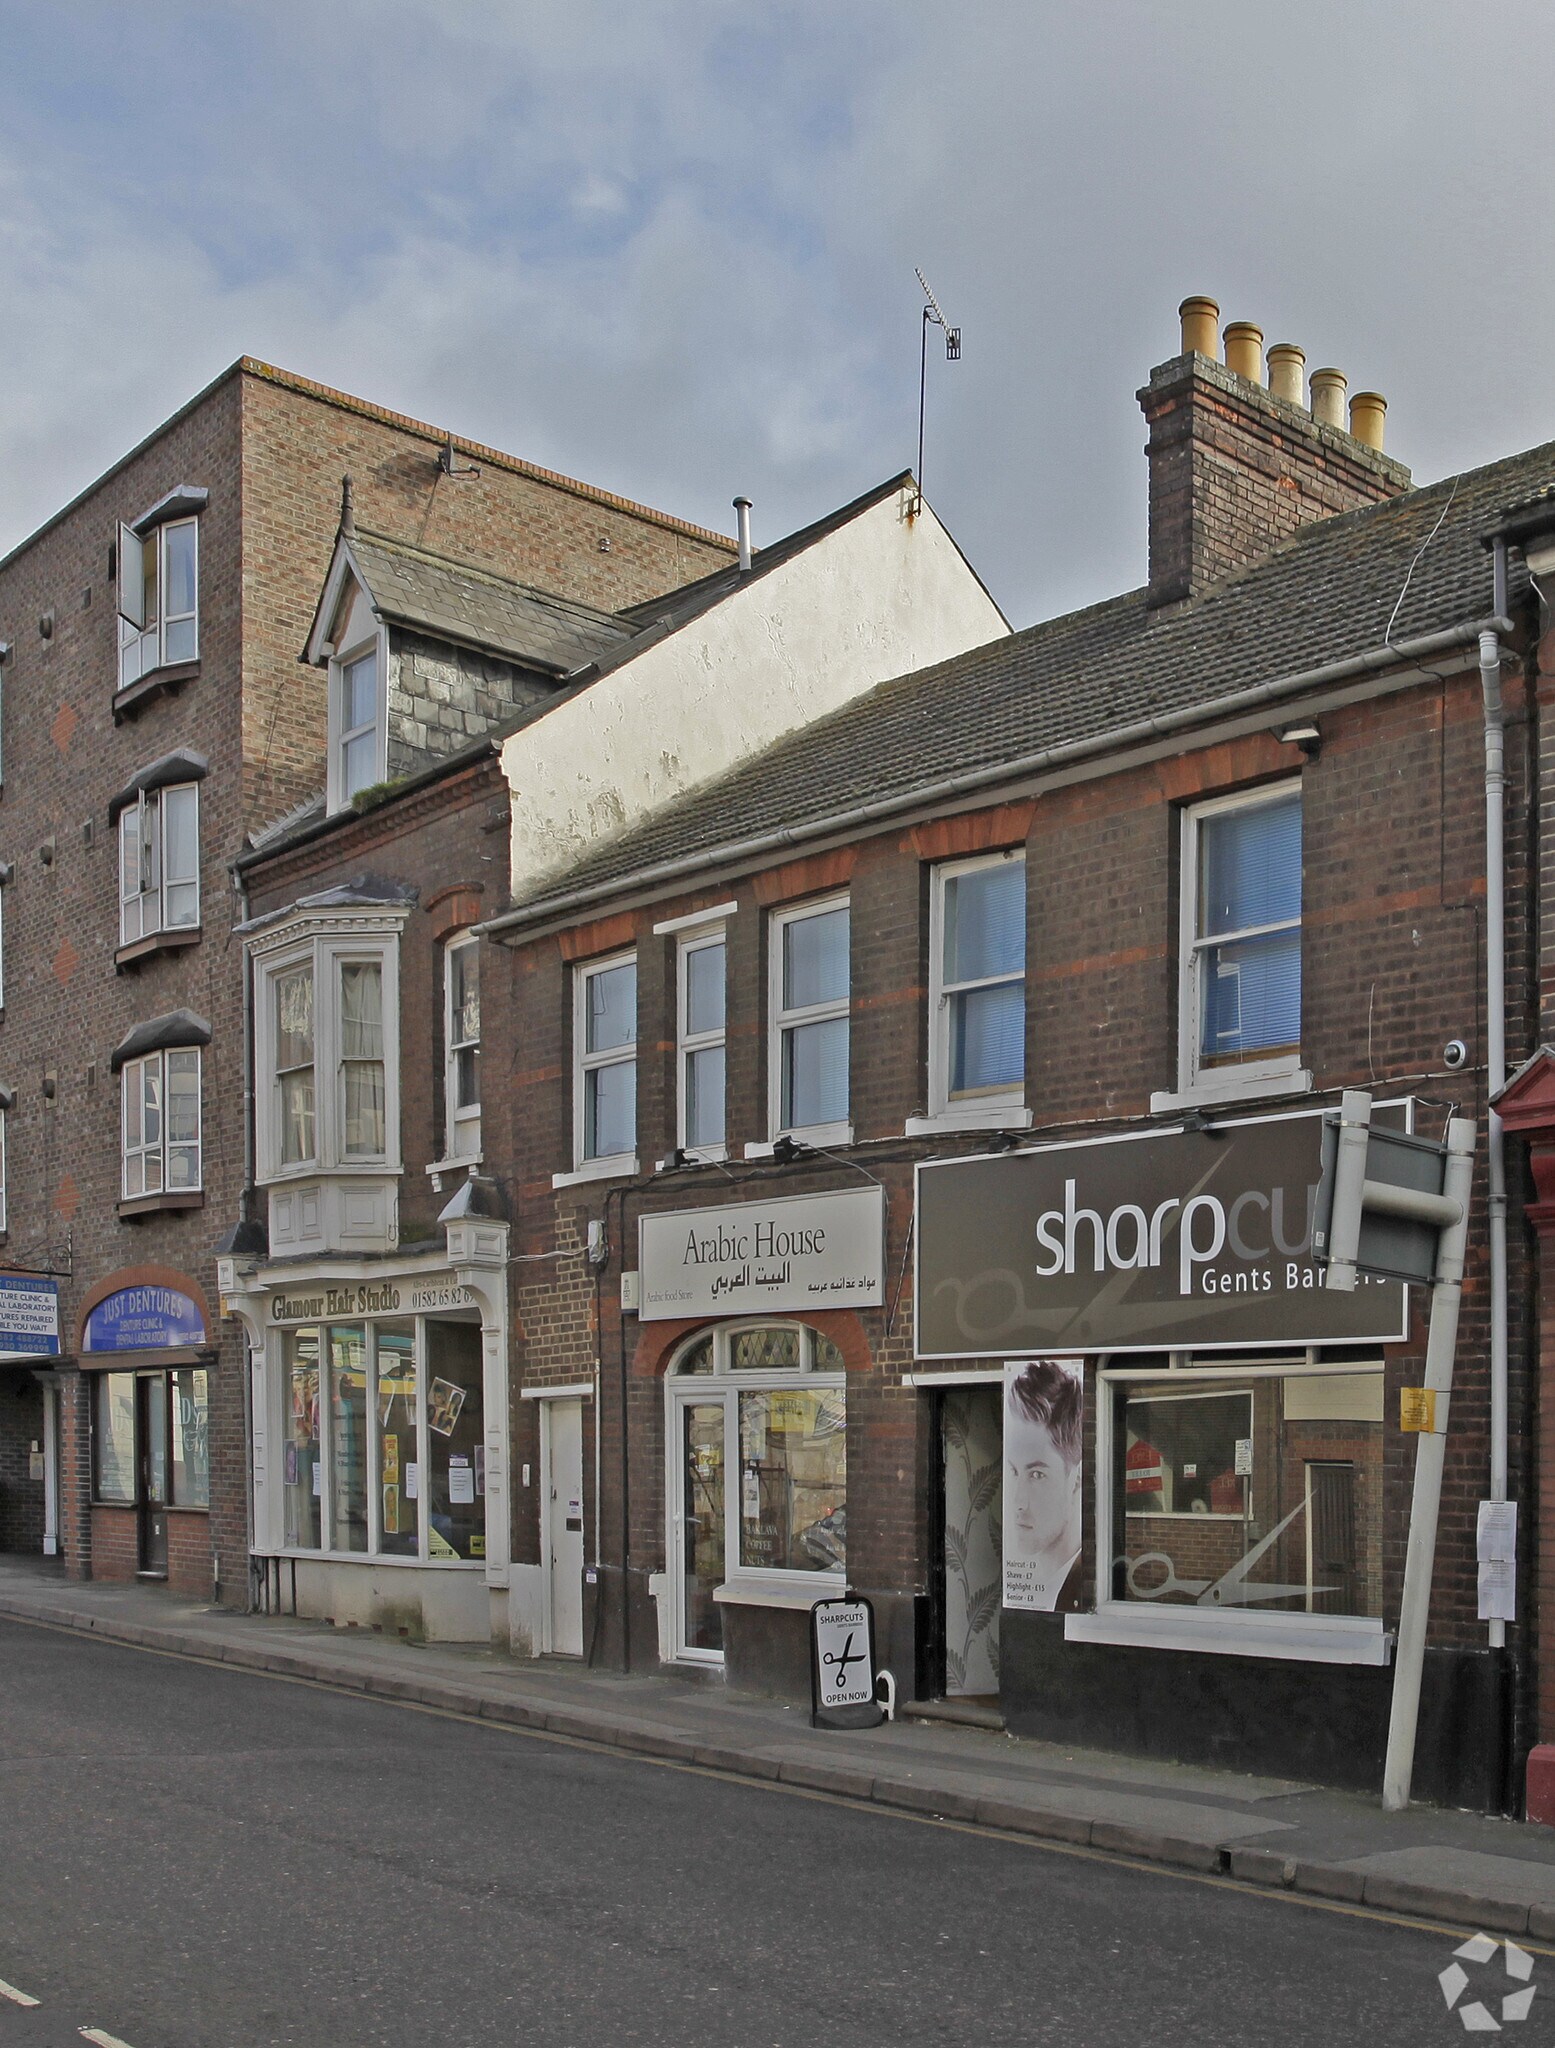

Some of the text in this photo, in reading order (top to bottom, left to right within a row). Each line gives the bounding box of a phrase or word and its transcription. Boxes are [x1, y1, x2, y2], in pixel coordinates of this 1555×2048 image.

[1036, 1179, 1317, 1294] sharpcu
[683, 1221, 825, 1265] Arabic House
[711, 1260, 791, 1299] البيت العربي
[1202, 1267, 1272, 1293] Gents
[5, 1280, 54, 1292] DENTURES
[20, 1294, 44, 1302] CLINIC
[272, 1282, 400, 1320] Glamour Hair Studio
[412, 1290, 436, 1308] 01582
[439, 1288, 448, 1305] 65
[451, 1287, 461, 1304] 82
[647, 1291, 664, 1302] Arabic
[8, 1302, 56, 1313] LABORATORY
[103, 1290, 183, 1325] JUST DENTURES
[21, 1314, 54, 1324] REPAIRED
[12, 1322, 28, 1331] YOU
[29, 1324, 48, 1332] WAIT
[746, 1555, 765, 1567] NUTS
[1007, 1560, 1026, 1569] Haircut
[1007, 1570, 1022, 1579] Shave
[1007, 1582, 1031, 1592] Highlight
[1035, 1584, 1045, 1592] £15
[820, 1613, 864, 1624] SHARPCUTS
[826, 1691, 868, 1703] OPEN NOW
